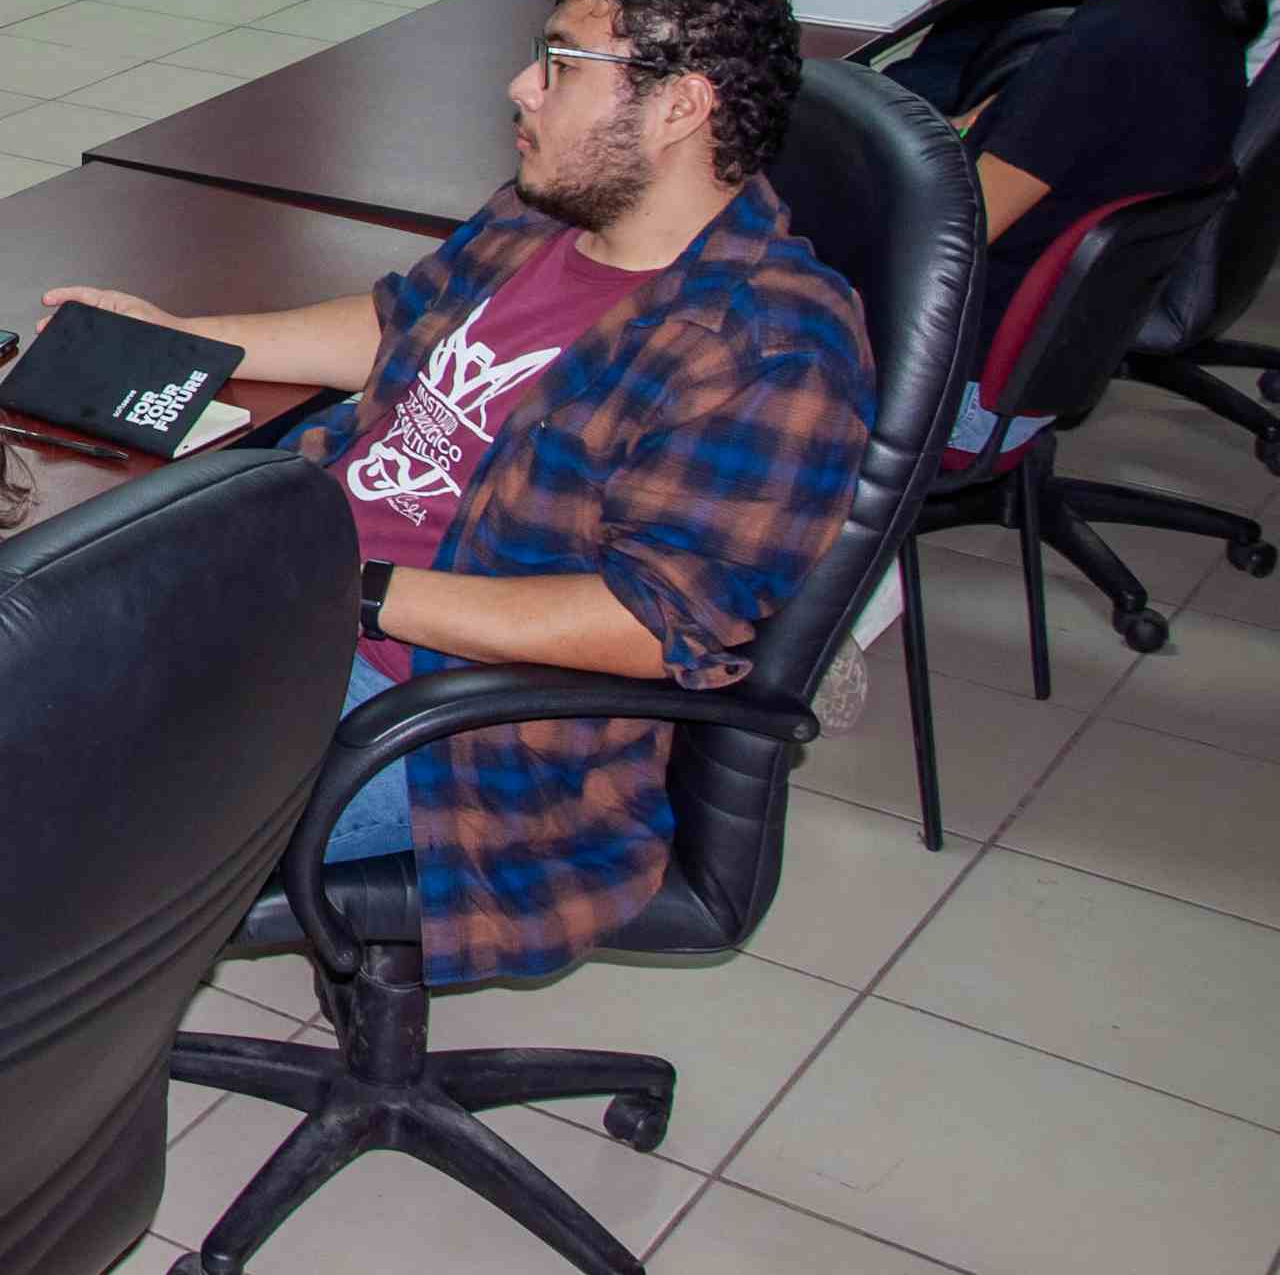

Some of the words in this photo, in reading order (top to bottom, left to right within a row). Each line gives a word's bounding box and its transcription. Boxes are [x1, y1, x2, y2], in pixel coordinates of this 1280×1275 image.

[126, 391, 159, 425] FOR
[138, 383, 181, 427] YOUR
[153, 370, 208, 432] FUTURE
